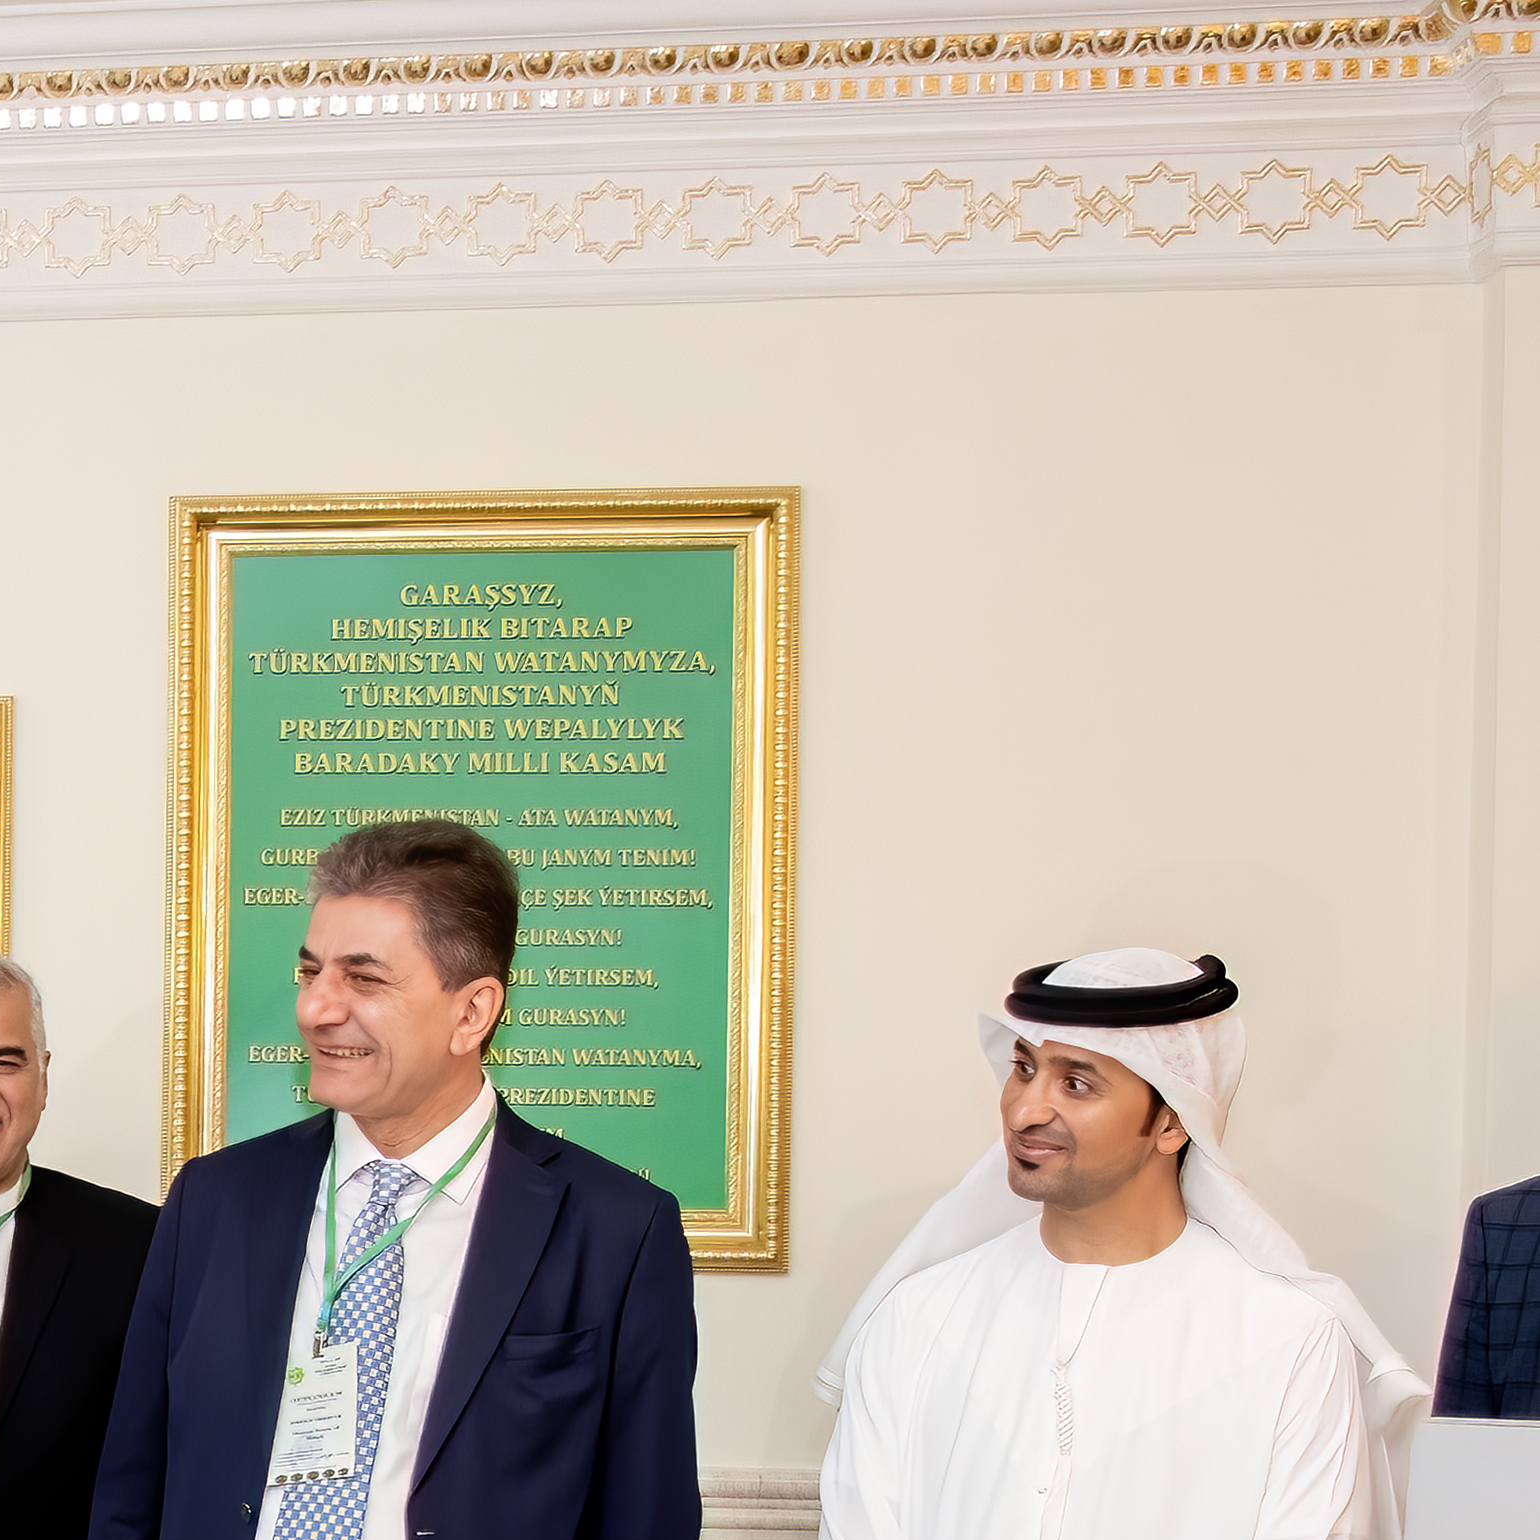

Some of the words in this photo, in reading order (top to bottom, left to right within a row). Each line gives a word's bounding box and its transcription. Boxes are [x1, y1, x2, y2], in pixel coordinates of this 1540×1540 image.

[399, 582, 564, 611] GARAŞSYZ,
[330, 616, 492, 645] HEMIŞELIK
[499, 615, 634, 640] BITARAP
[249, 647, 485, 676] TÜRKMENISTAN
[494, 649, 717, 677] WATANYMYZA,
[340, 678, 622, 708] TÜRKMENISTANYŇ
[279, 717, 496, 742] PREZIDENTINE
[503, 717, 684, 741] WEPALYLYK
[293, 751, 460, 776] BARADAKY
[467, 751, 550, 776] MILLI
[558, 751, 668, 775] KASAM
[280, 808, 326, 827] EZIZ
[517, 808, 559, 828] ATA
[563, 808, 679, 829] WATANYM,
[541, 848, 612, 870] JANYM
[618, 848, 696, 868] TENIM!
[552, 888, 593, 911] ŞEK
[598, 885, 714, 910] ÝETIRSEM,
[514, 928, 623, 947] GURASYN!
[544, 963, 660, 989] ÝETIRSEM,
[518, 1008, 626, 1027] GURASYN!
[573, 1049, 702, 1070] WATANYMA,
[498, 1087, 656, 1107] PREZIDENTINE
